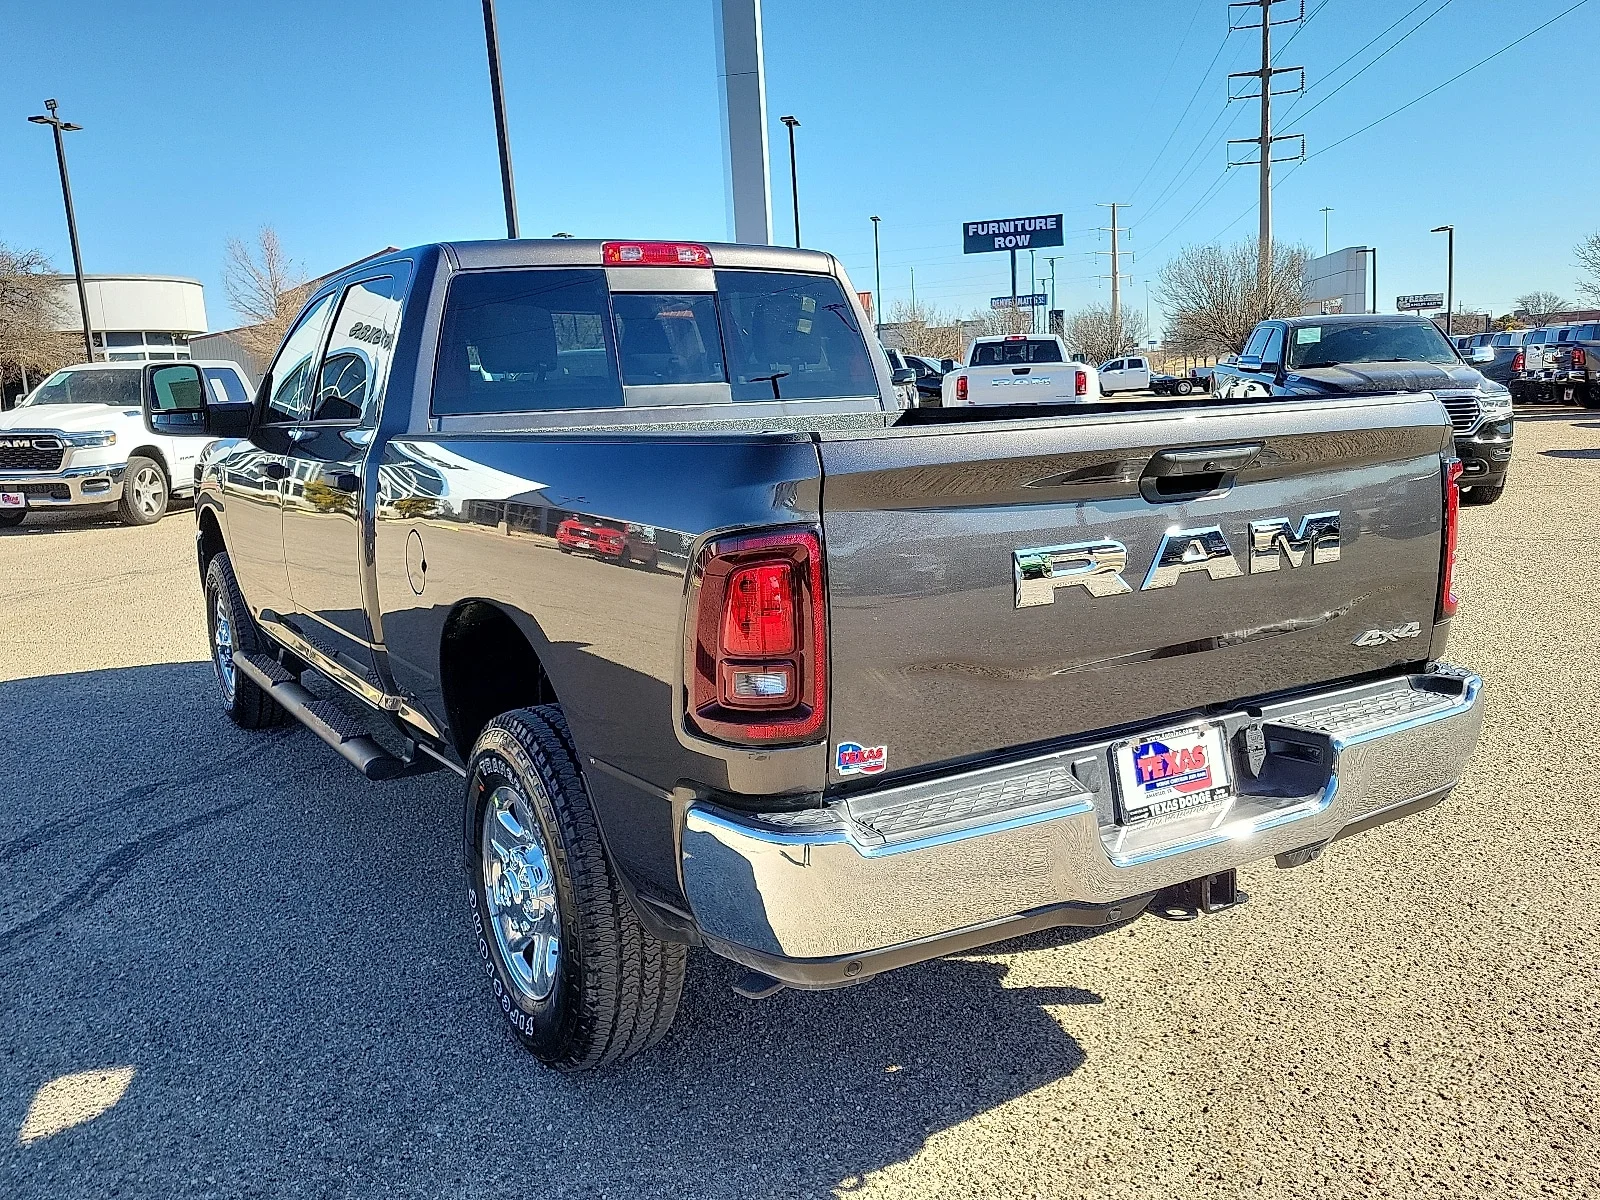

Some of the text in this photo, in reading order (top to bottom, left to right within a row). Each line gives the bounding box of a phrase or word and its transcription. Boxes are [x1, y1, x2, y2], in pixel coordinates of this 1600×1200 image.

[968, 218, 1057, 236] FURNITURE
[994, 234, 1031, 249] ROW
[991, 377, 1051, 387] RAM
[0, 439, 31, 448] AM
[1012, 510, 1341, 609] RAM
[840, 747, 884, 765] TEXAS
[1137, 745, 1206, 782] TEXAS
[1149, 798, 1179, 817] TEXAS
[1179, 790, 1212, 809] DODGE
